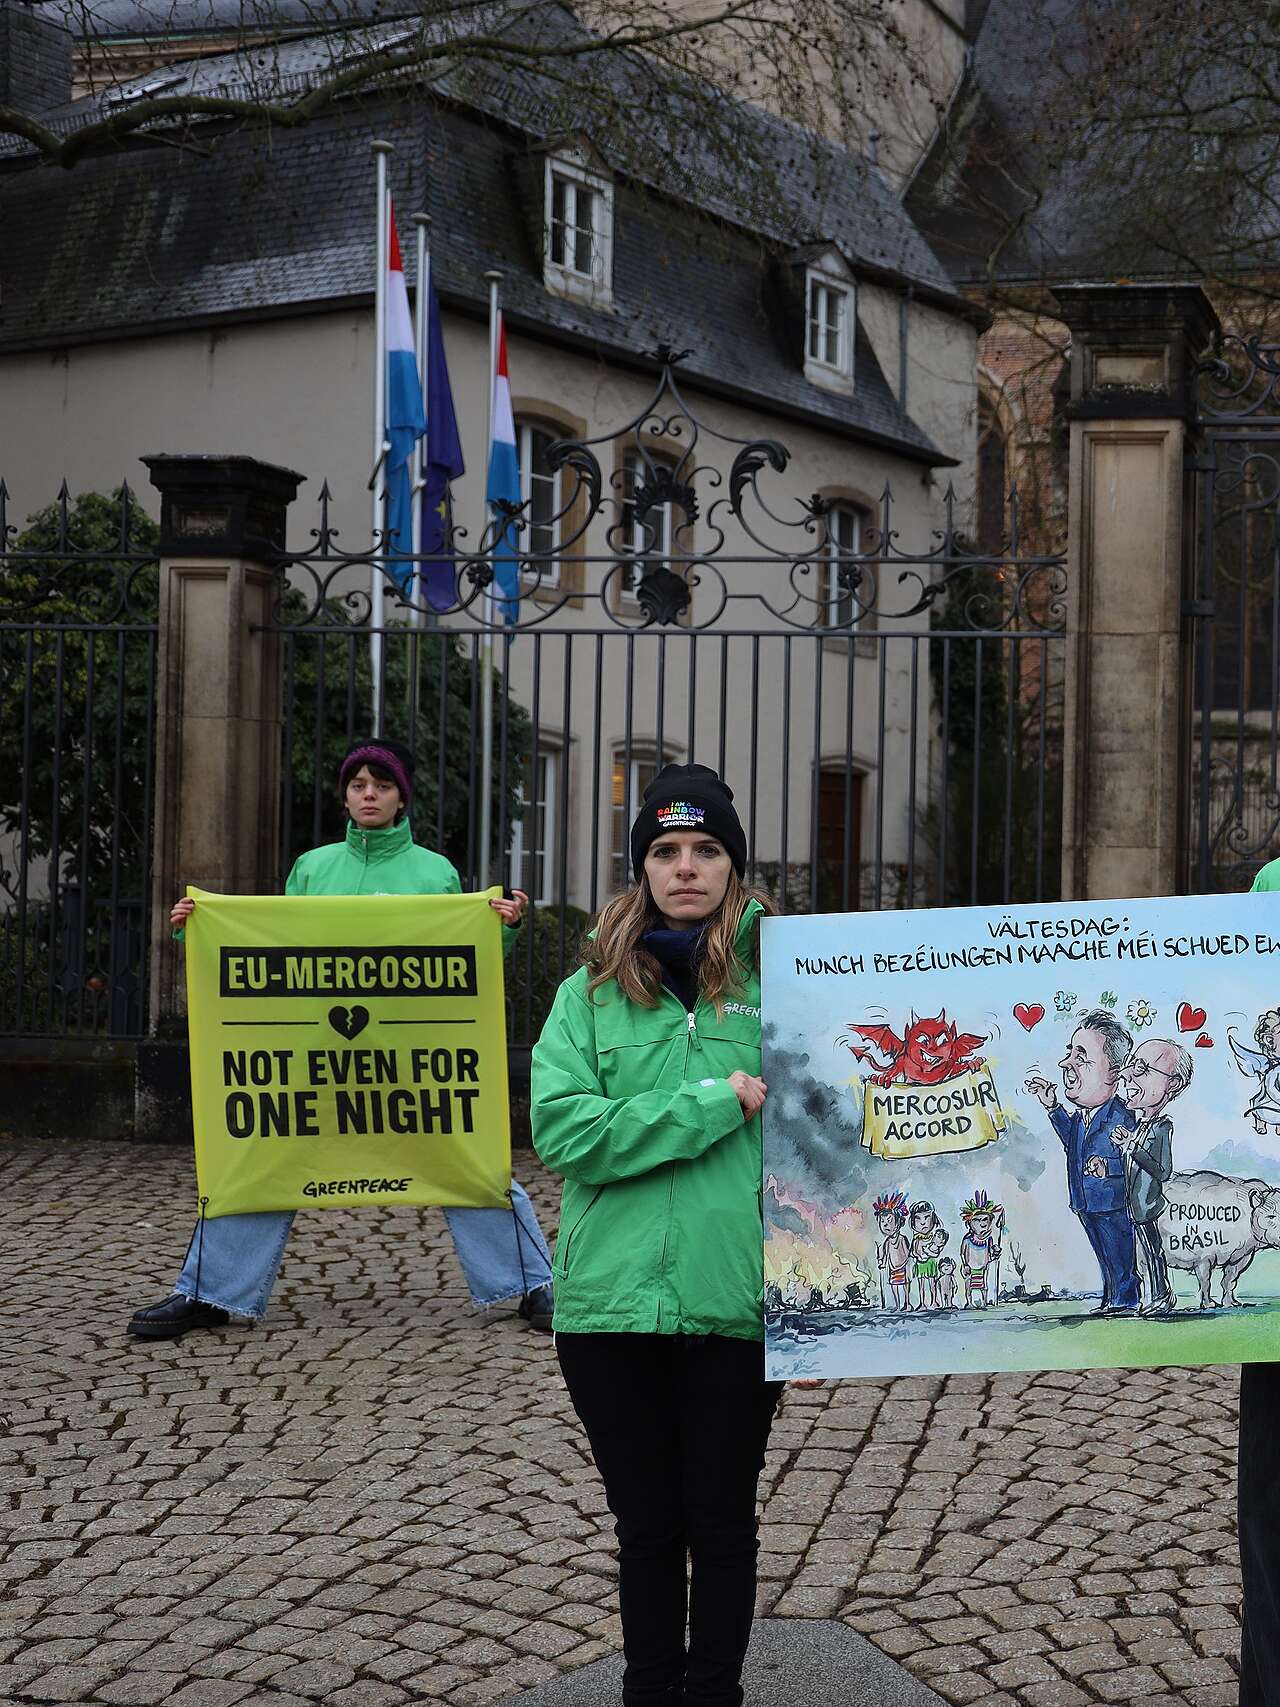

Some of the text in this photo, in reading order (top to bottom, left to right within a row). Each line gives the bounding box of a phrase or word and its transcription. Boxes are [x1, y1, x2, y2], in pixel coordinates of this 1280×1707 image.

[657, 806, 705, 816] RAINBOW
[657, 813, 704, 823] WARRIOR
[987, 915, 1130, 939] VÄLTESDAG:
[795, 953, 865, 976] MUNCH
[1018, 940, 1111, 964] MAACHE
[1164, 934, 1249, 957] SCHUED
[227, 955, 469, 991] EU-MERCOSUR
[722, 1001, 761, 1018] GREEN
[223, 1047, 480, 1087] NOT EVEN FOR
[873, 1080, 996, 1116] MERCOSUR
[225, 1088, 480, 1139] ONE NIGHT
[884, 1116, 972, 1141] ACCORD
[302, 1177, 414, 1197] GREENPEACE
[1169, 1203, 1241, 1222] PRODUCED
[1169, 1229, 1230, 1251] BRASIL
